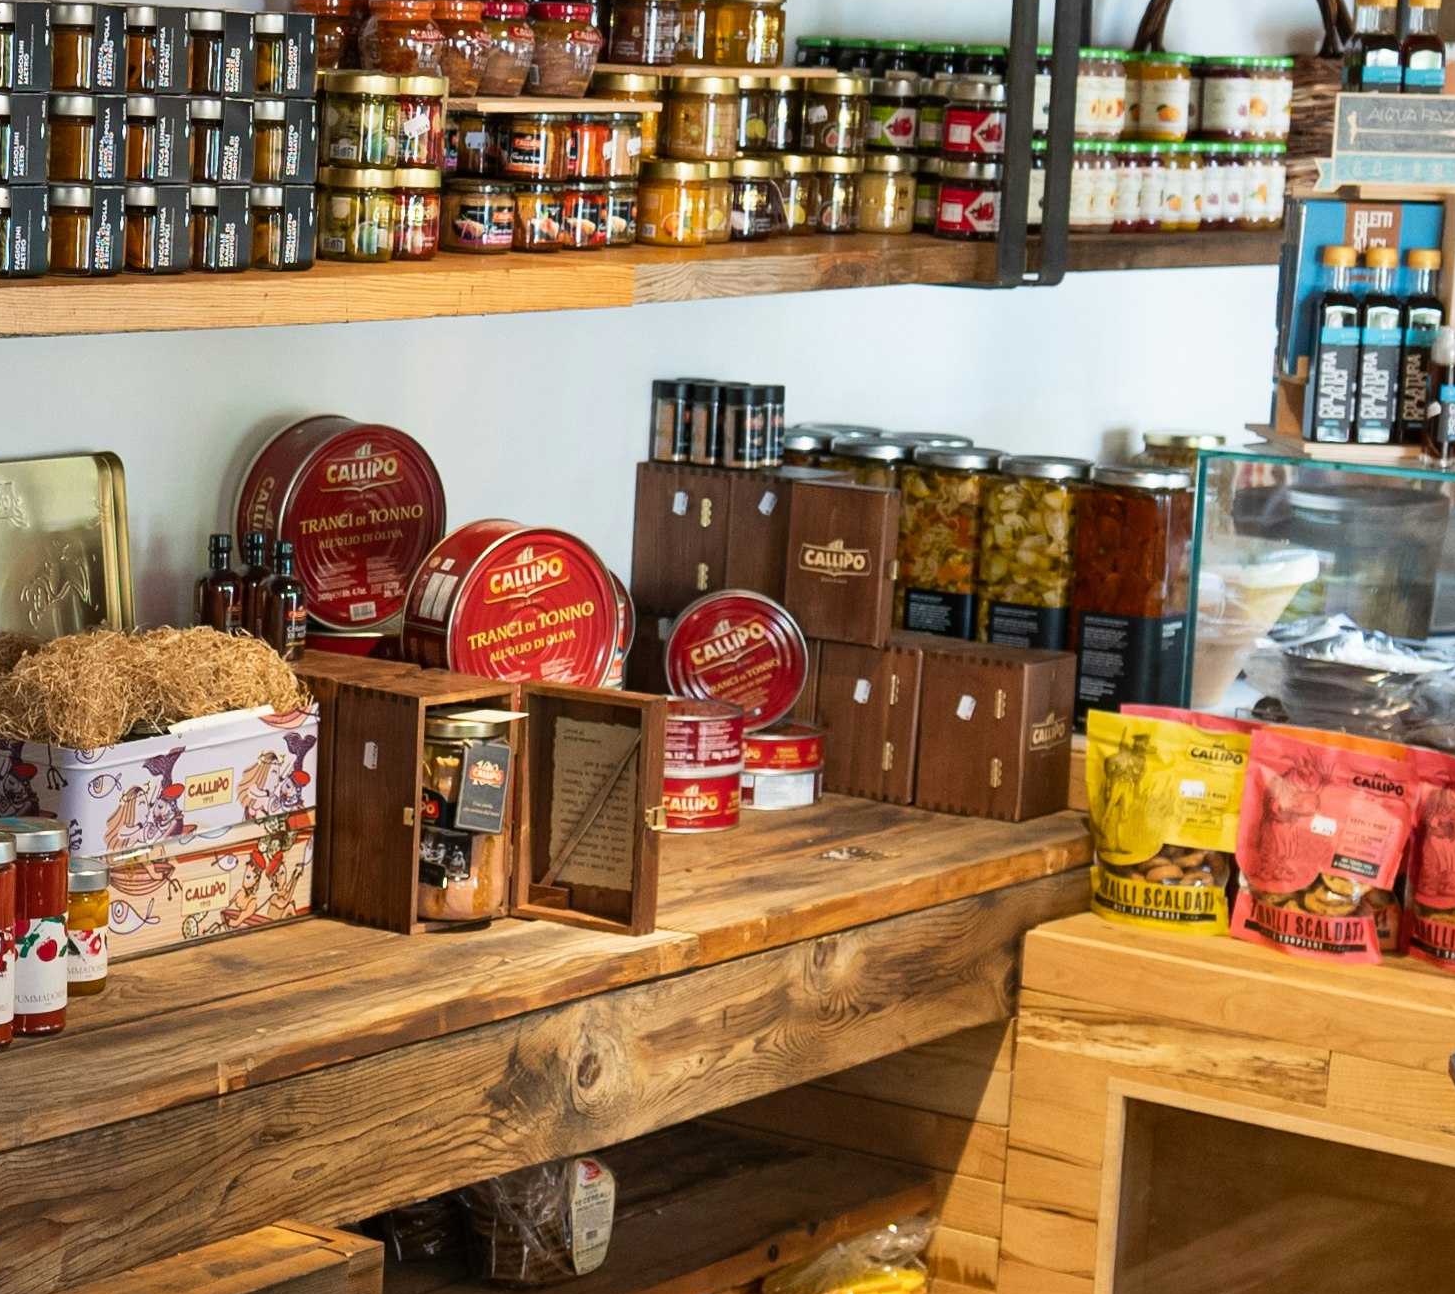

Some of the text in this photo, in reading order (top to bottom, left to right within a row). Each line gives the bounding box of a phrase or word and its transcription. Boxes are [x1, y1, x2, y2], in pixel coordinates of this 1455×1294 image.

[1319, 352, 1337, 419] COLATURA
[326, 457, 398, 484] CALLIPO
[299, 513, 354, 536] TRANCI
[369, 505, 424, 524] TONNO
[375, 530, 403, 542] OLIVA
[804, 549, 867, 570] CALLIPO
[489, 556, 563, 595] CALLIPO
[468, 618, 524, 651] TRANCI
[537, 601, 595, 629] TONNO
[546, 629, 576, 647] OLIVA
[690, 621, 766, 667] CALLIPO
[1190, 747, 1243, 766] CALLIPO
[187, 777, 230, 799] CALLIPO
[1352, 775, 1405, 797] CALLIPO
[661, 794, 719, 812] CALLIPO
[184, 881, 227, 903] CALLIPO
